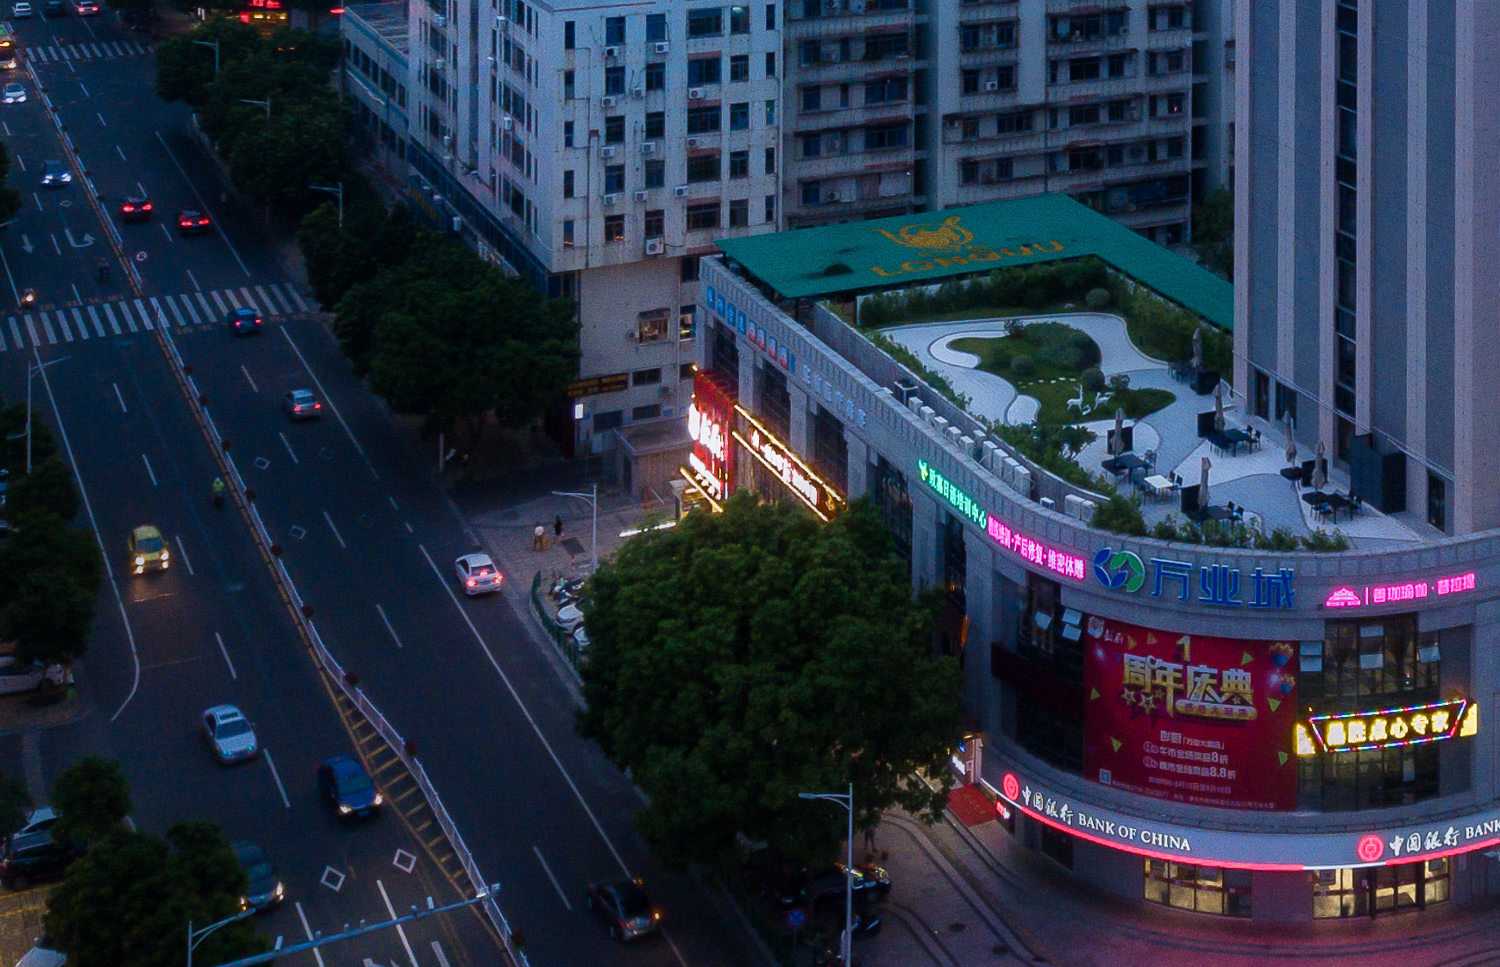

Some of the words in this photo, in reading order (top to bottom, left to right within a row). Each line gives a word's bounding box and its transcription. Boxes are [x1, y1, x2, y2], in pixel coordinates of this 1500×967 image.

[1149, 556, 1297, 610] 万业城
[1175, 635, 1192, 662] 1
[1122, 652, 1254, 718] 周年庆典
[1021, 784, 1076, 826] 中国银行
[1078, 812, 1116, 836] BANK
[1117, 824, 1138, 840] OF
[1140, 829, 1192, 852] CHINA
[1389, 826, 1461, 857] 中国银行
